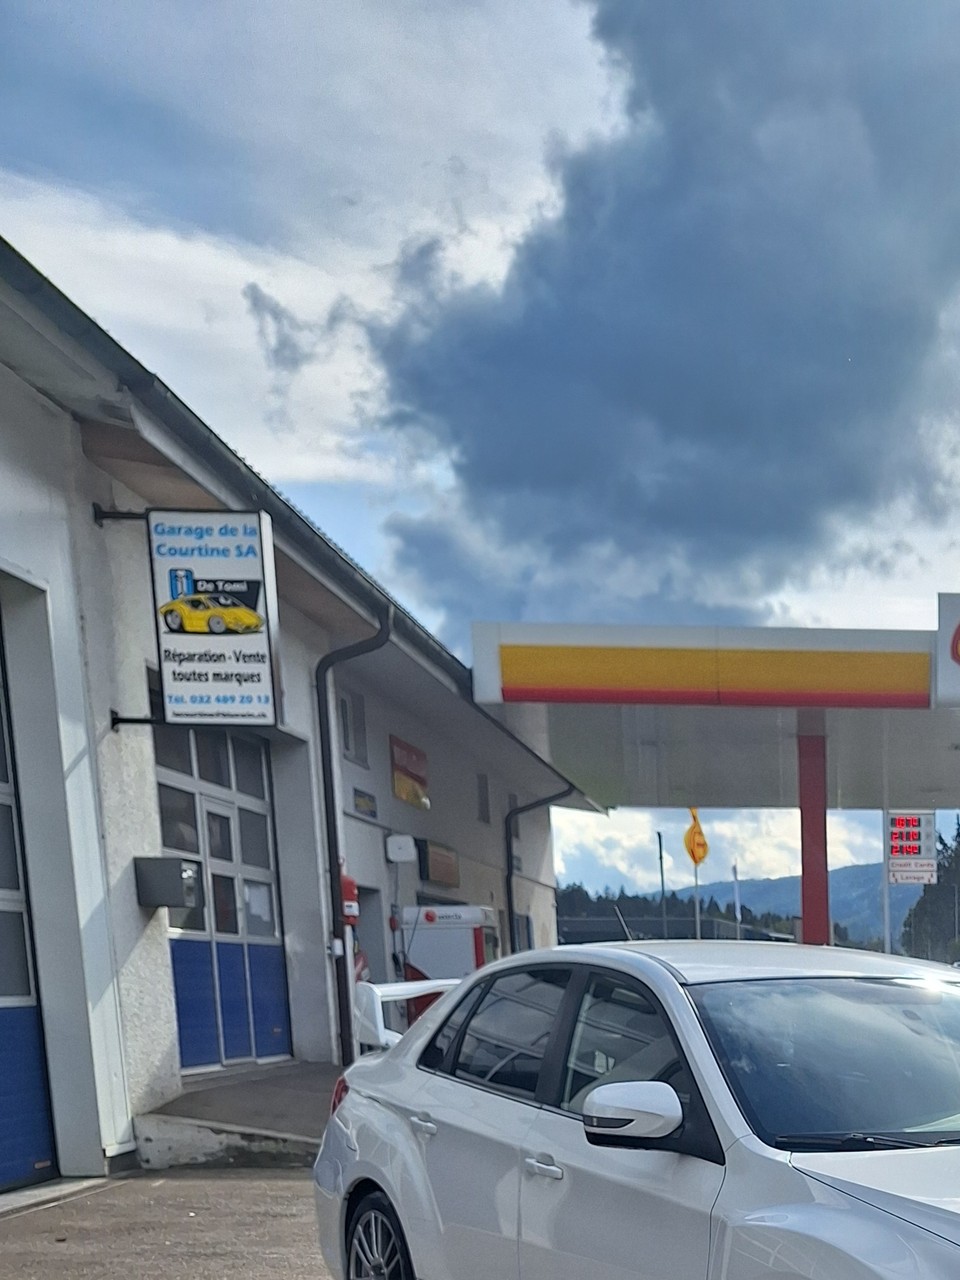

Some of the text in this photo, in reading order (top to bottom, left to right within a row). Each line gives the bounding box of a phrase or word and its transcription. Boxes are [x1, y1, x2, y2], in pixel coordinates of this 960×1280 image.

[154, 523, 257, 540] Garage de la
[156, 543, 257, 557] Courtine SA
[197, 580, 214, 592] De
[164, 648, 226, 667] Réparation
[233, 649, 267, 664] Vente
[172, 669, 261, 686] toutes marques
